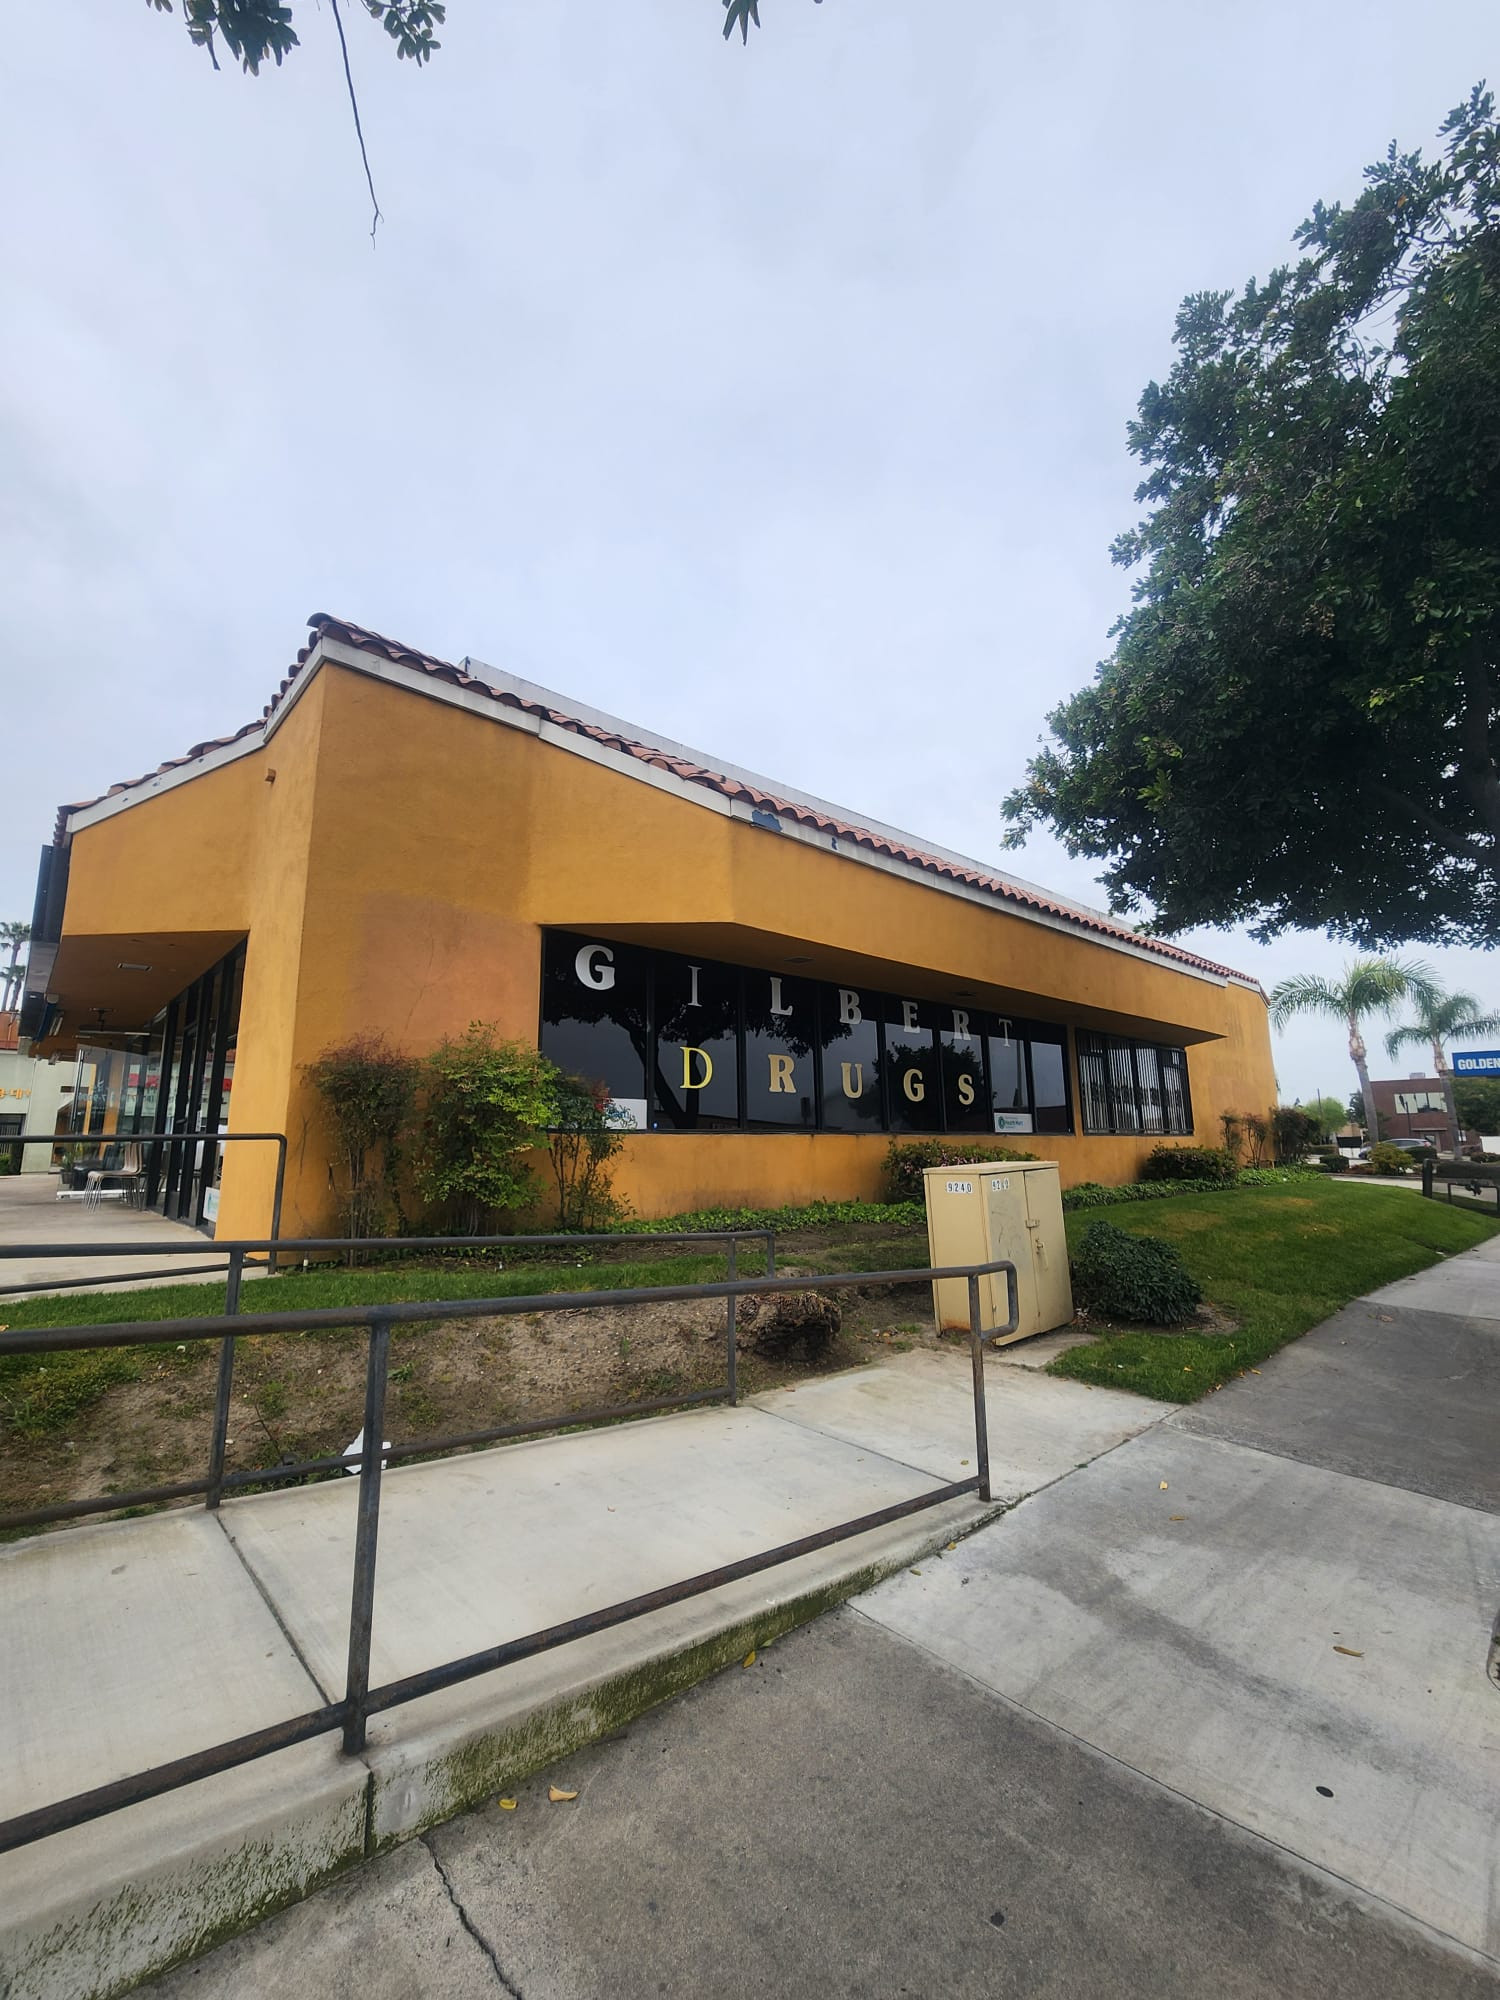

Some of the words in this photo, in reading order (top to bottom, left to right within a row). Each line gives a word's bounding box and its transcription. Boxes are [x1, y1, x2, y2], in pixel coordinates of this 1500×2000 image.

[575, 944, 1013, 1047] GILBERT
[680, 1046, 975, 1105] DRUGS
[948, 1182, 972, 1193] 9240
